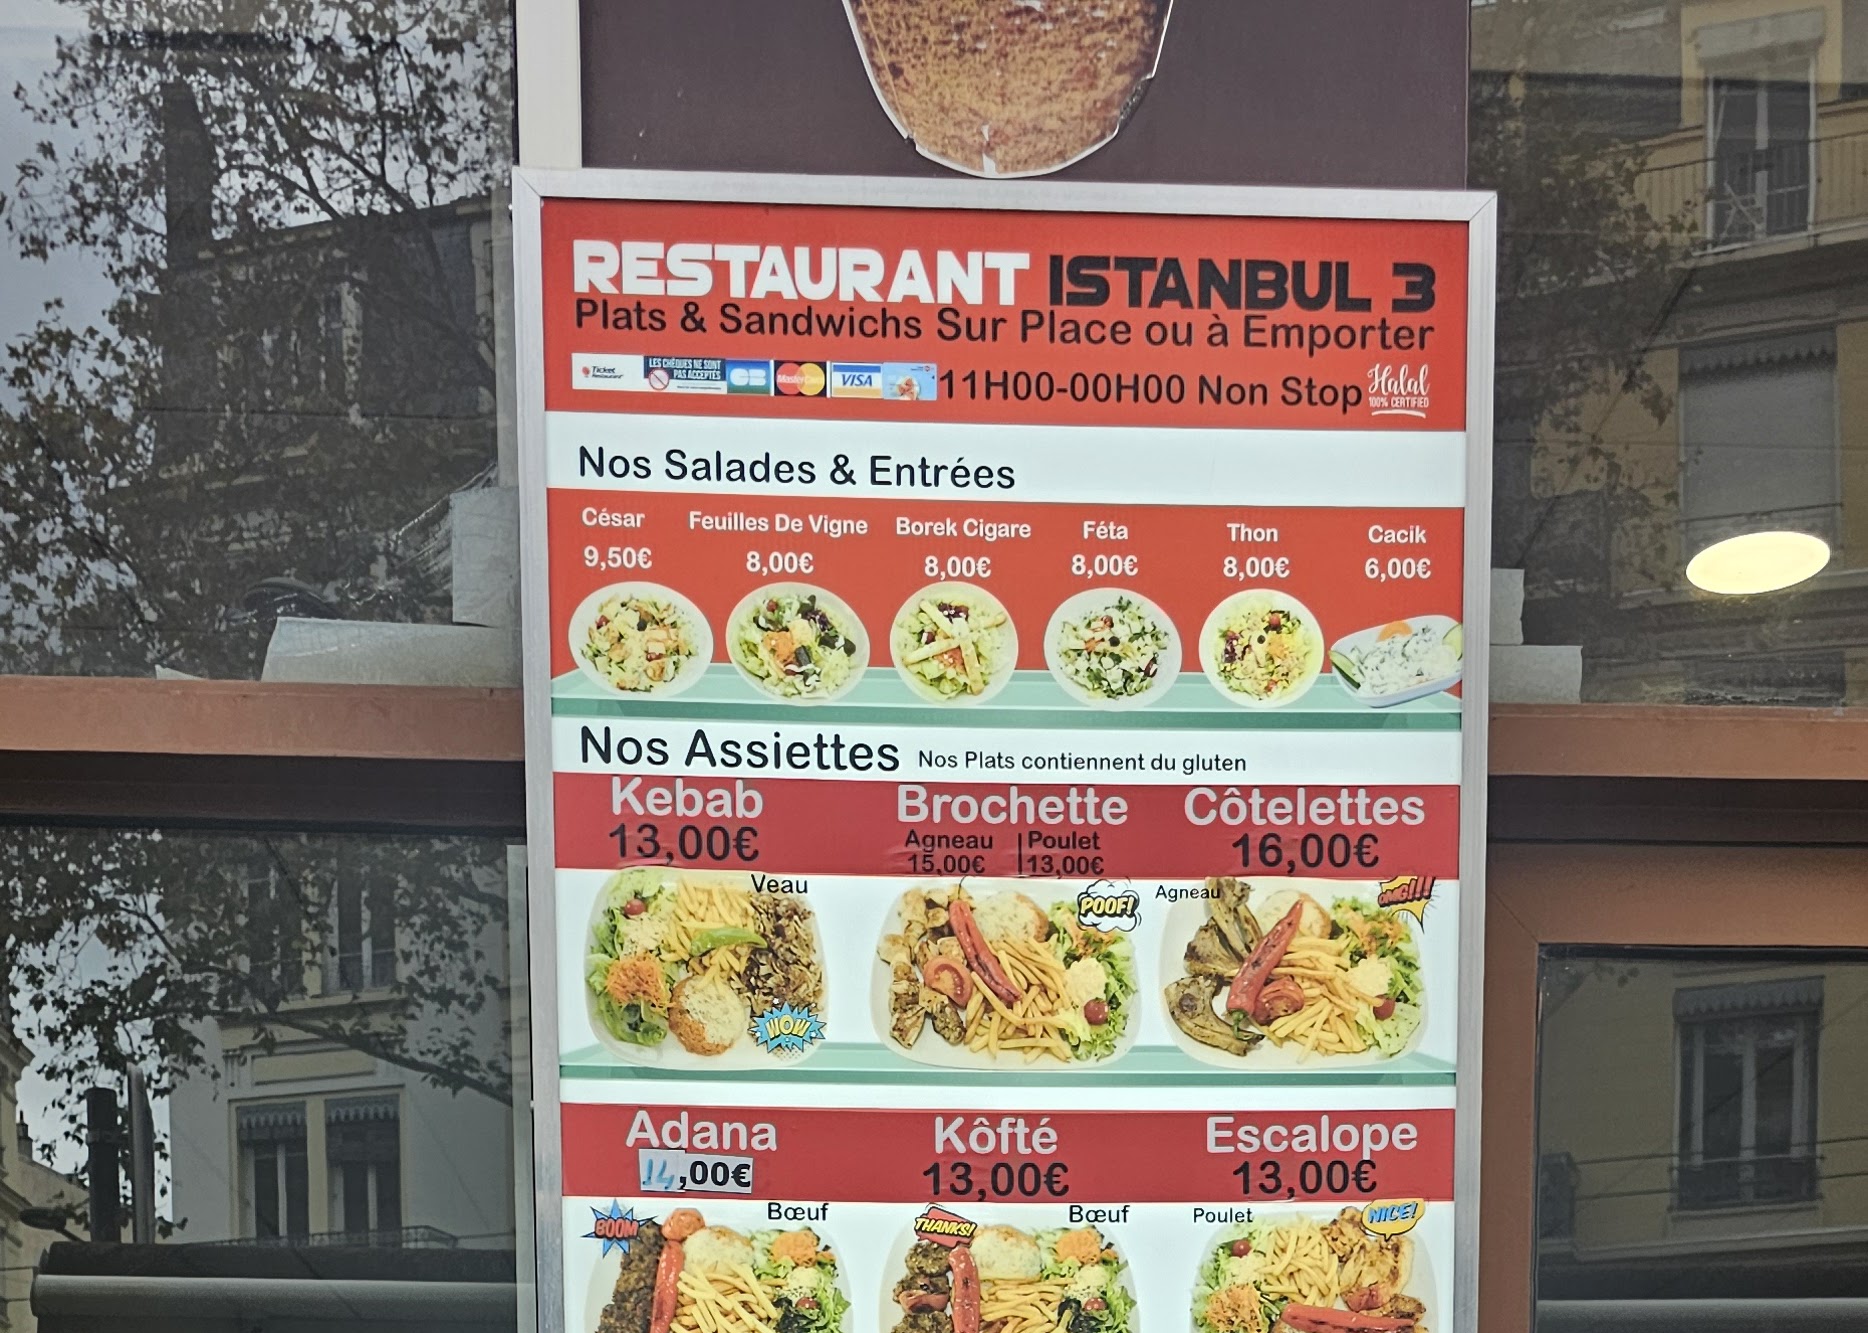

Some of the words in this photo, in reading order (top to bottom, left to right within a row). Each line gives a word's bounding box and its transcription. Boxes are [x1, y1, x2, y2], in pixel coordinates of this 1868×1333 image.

[573, 240, 1030, 306] RESTAURANT
[1049, 254, 1372, 312] ISTANBUL
[1391, 262, 1436, 313] 3
[575, 299, 667, 332] Plats
[680, 303, 706, 333] &
[719, 303, 922, 340] Sandwichs
[937, 309, 1006, 343] Sur
[1021, 310, 1131, 345] Place
[1145, 321, 1192, 346] ou
[1207, 315, 1228, 348] à
[1244, 316, 1434, 358] Emporter
[649, 358, 661, 367] LES
[693, 359, 702, 368] NE
[704, 360, 721, 369] SONT
[673, 370, 686, 379] PAS
[842, 374, 872, 386] VISA
[939, 369, 1184, 404] 11H00-00H00
[1199, 375, 1268, 406] Non
[1280, 377, 1362, 414] Stop
[578, 446, 651, 479] Nos
[665, 449, 816, 484] Salades
[830, 453, 856, 485] &
[870, 455, 1015, 489] Entrées
[582, 507, 644, 529] César
[689, 511, 769, 532] Feuilles
[775, 515, 803, 533] De
[809, 515, 868, 538] Vigne
[584, 545, 652, 572] 9,50€
[746, 551, 814, 578] 8,00€
[581, 725, 669, 766] Nos
[685, 729, 900, 772] Assiettes
[919, 750, 959, 769] Nos
[965, 752, 1015, 770] Plats
[1021, 753, 1146, 772] contiennent
[1151, 754, 1176, 771] du
[1182, 754, 1246, 775] gluten
[897, 784, 1128, 825] Brochette
[905, 831, 992, 851] Agneau
[1028, 831, 1101, 850] Poulet
[751, 874, 808, 894] Veau
[1079, 896, 1136, 918] POOF!
[766, 1015, 810, 1039] WOW
[626, 1110, 777, 1150] Adana
[1206, 1116, 1418, 1160] Escalope
[1366, 1201, 1417, 1224] NICE!
[915, 1216, 977, 1238] THANKS!
